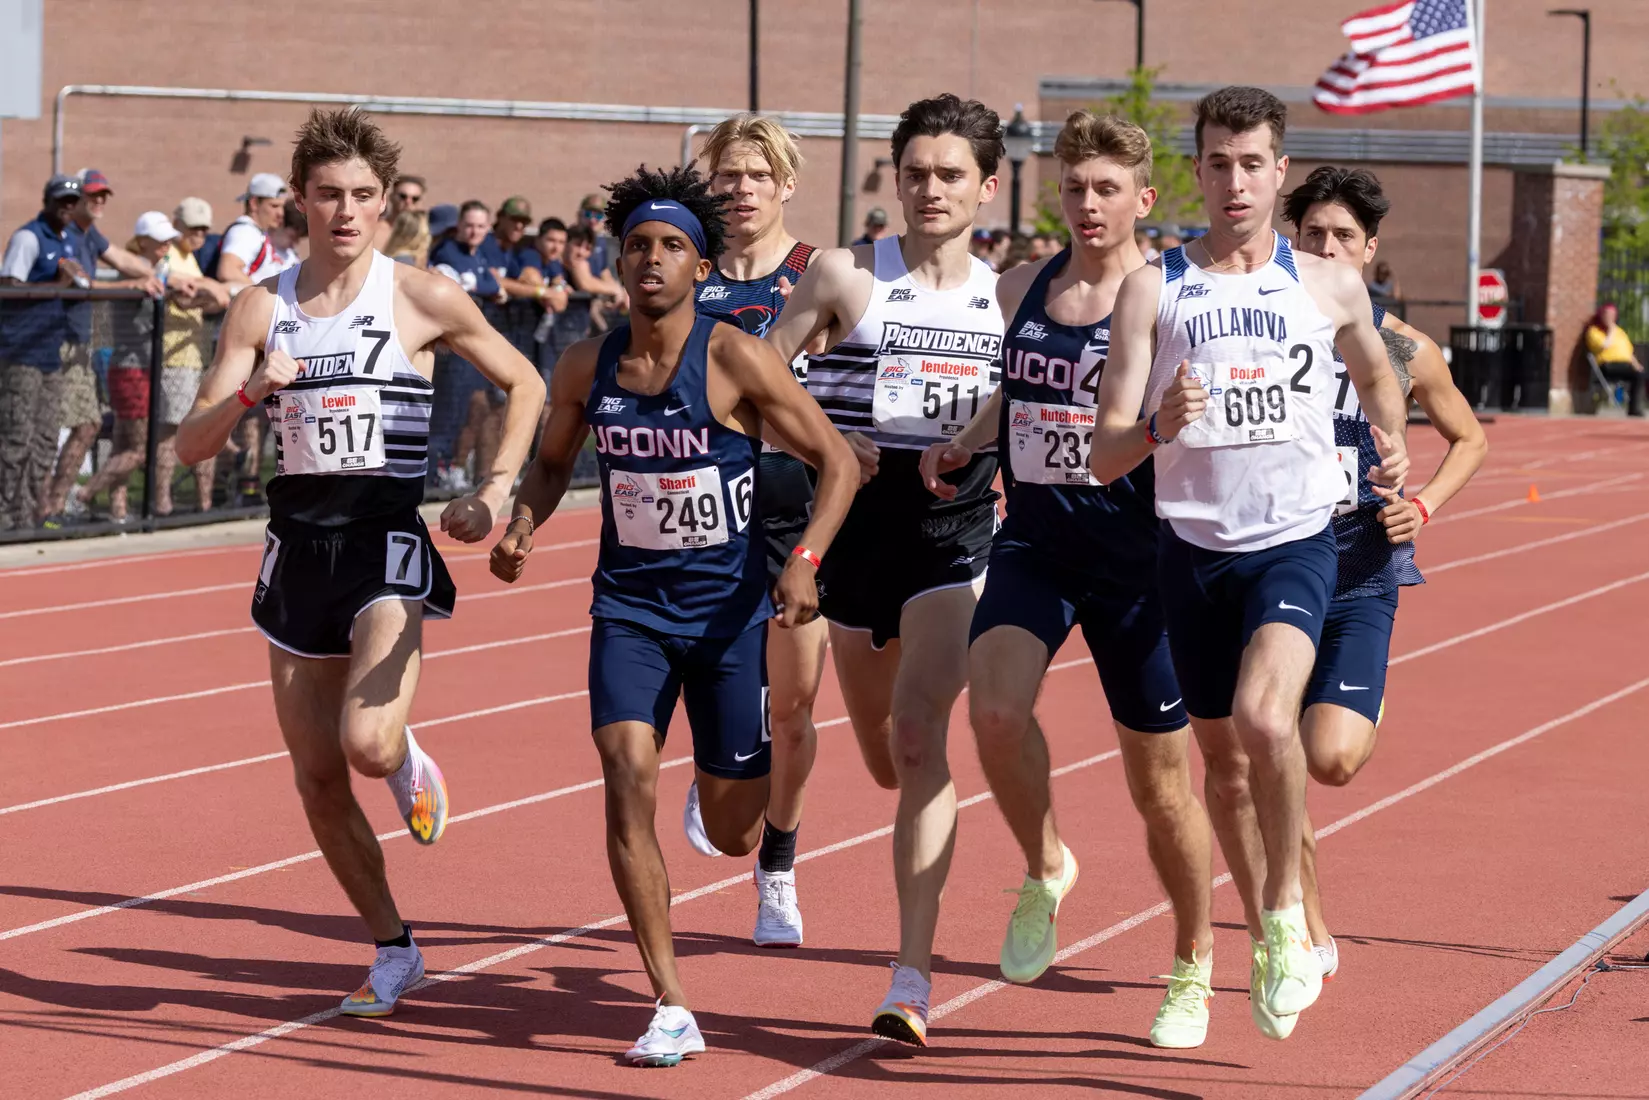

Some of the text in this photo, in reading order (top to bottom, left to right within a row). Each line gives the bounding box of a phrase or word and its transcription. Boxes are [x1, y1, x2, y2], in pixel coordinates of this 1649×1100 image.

[1178, 290, 1211, 298] EAST
[1181, 284, 1205, 292] BIG
[1019, 329, 1048, 339] EAST
[1024, 321, 1045, 331] BIG
[1185, 307, 1287, 349] VILLANOVA
[879, 322, 1001, 357] PROVIDENCE
[362, 329, 391, 375] 7
[920, 360, 979, 377] Jendzejec
[1006, 348, 1078, 391] UCO
[1230, 366, 1265, 381] Dolan
[1289, 343, 1313, 394] 2
[1079, 358, 1107, 405] 4
[322, 394, 356, 408] Lewin
[598, 404, 626, 413] EAST
[602, 396, 622, 405] BIG
[922, 381, 980, 421] 511
[1224, 384, 1287, 427] 609
[284, 412, 302, 420] EAST
[1013, 418, 1032, 426] EAST
[1016, 412, 1028, 420] BIG
[1040, 408, 1094, 424] Hutchens
[318, 413, 376, 455] 517
[590, 424, 709, 458] UCONN
[659, 476, 696, 489] Sharif
[735, 476, 752, 523] 6
[656, 493, 719, 534] 249
[392, 536, 417, 580] 7
